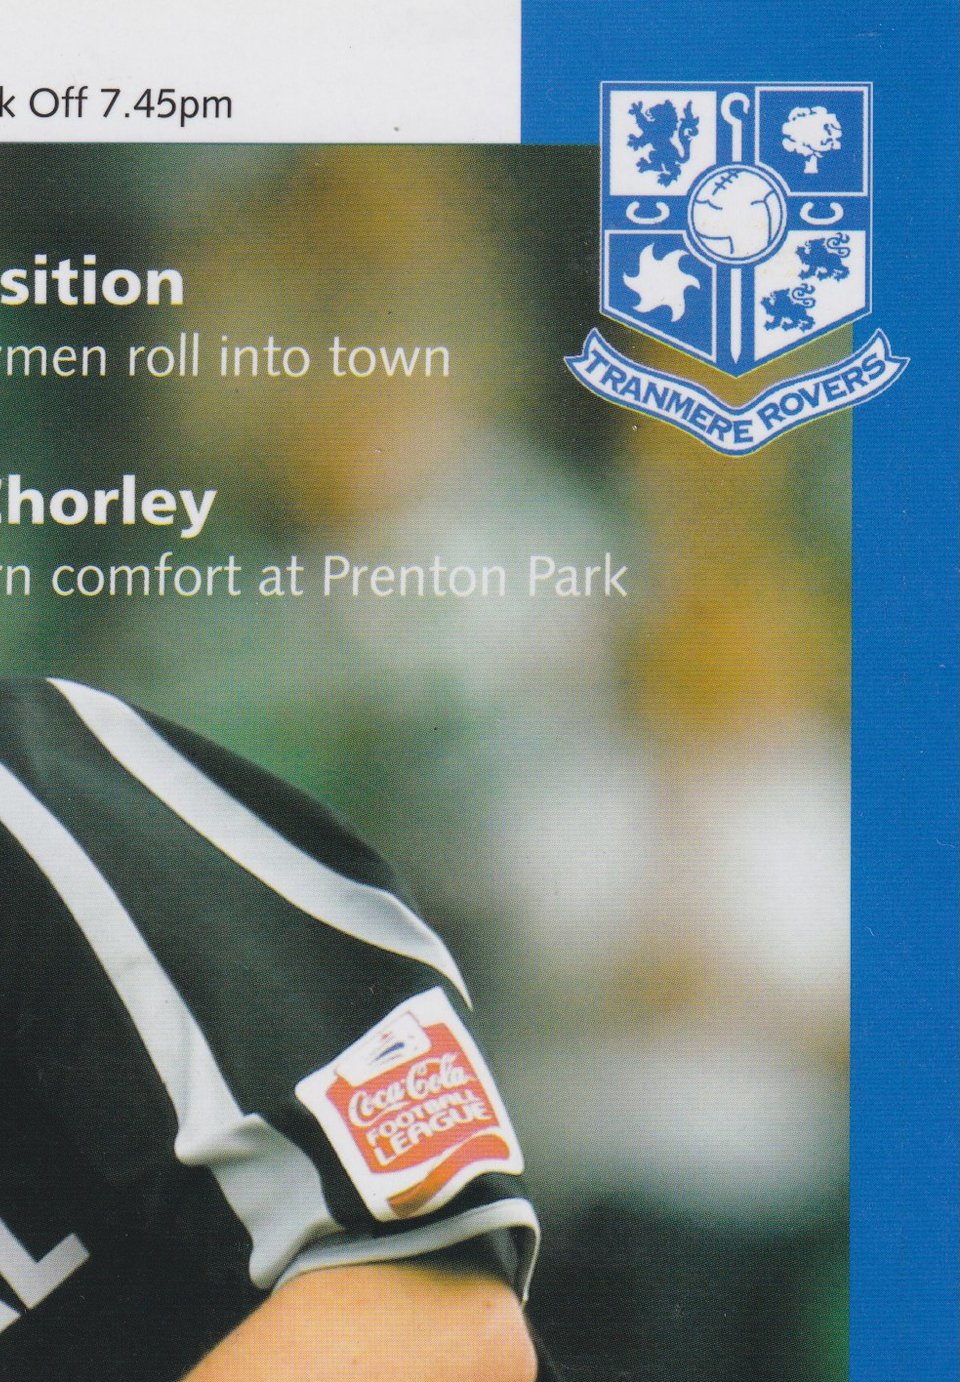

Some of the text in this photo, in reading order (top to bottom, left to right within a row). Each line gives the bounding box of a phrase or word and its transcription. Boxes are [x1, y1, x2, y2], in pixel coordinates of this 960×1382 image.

[29, 85, 89, 118] Off
[100, 88, 232, 128] 7.45pm
[129, 329, 200, 377] roll
[219, 334, 311, 377] into
[328, 335, 451, 377] town
[584, 349, 887, 444] TRANMERE ROVERS
[51, 551, 243, 597] comfort
[258, 555, 306, 597] at
[324, 553, 508, 597] Prenton
[530, 553, 628, 597] Park
[367, 1090, 484, 1147] FOOTBALL
[374, 1103, 492, 1166] LEAGUE
